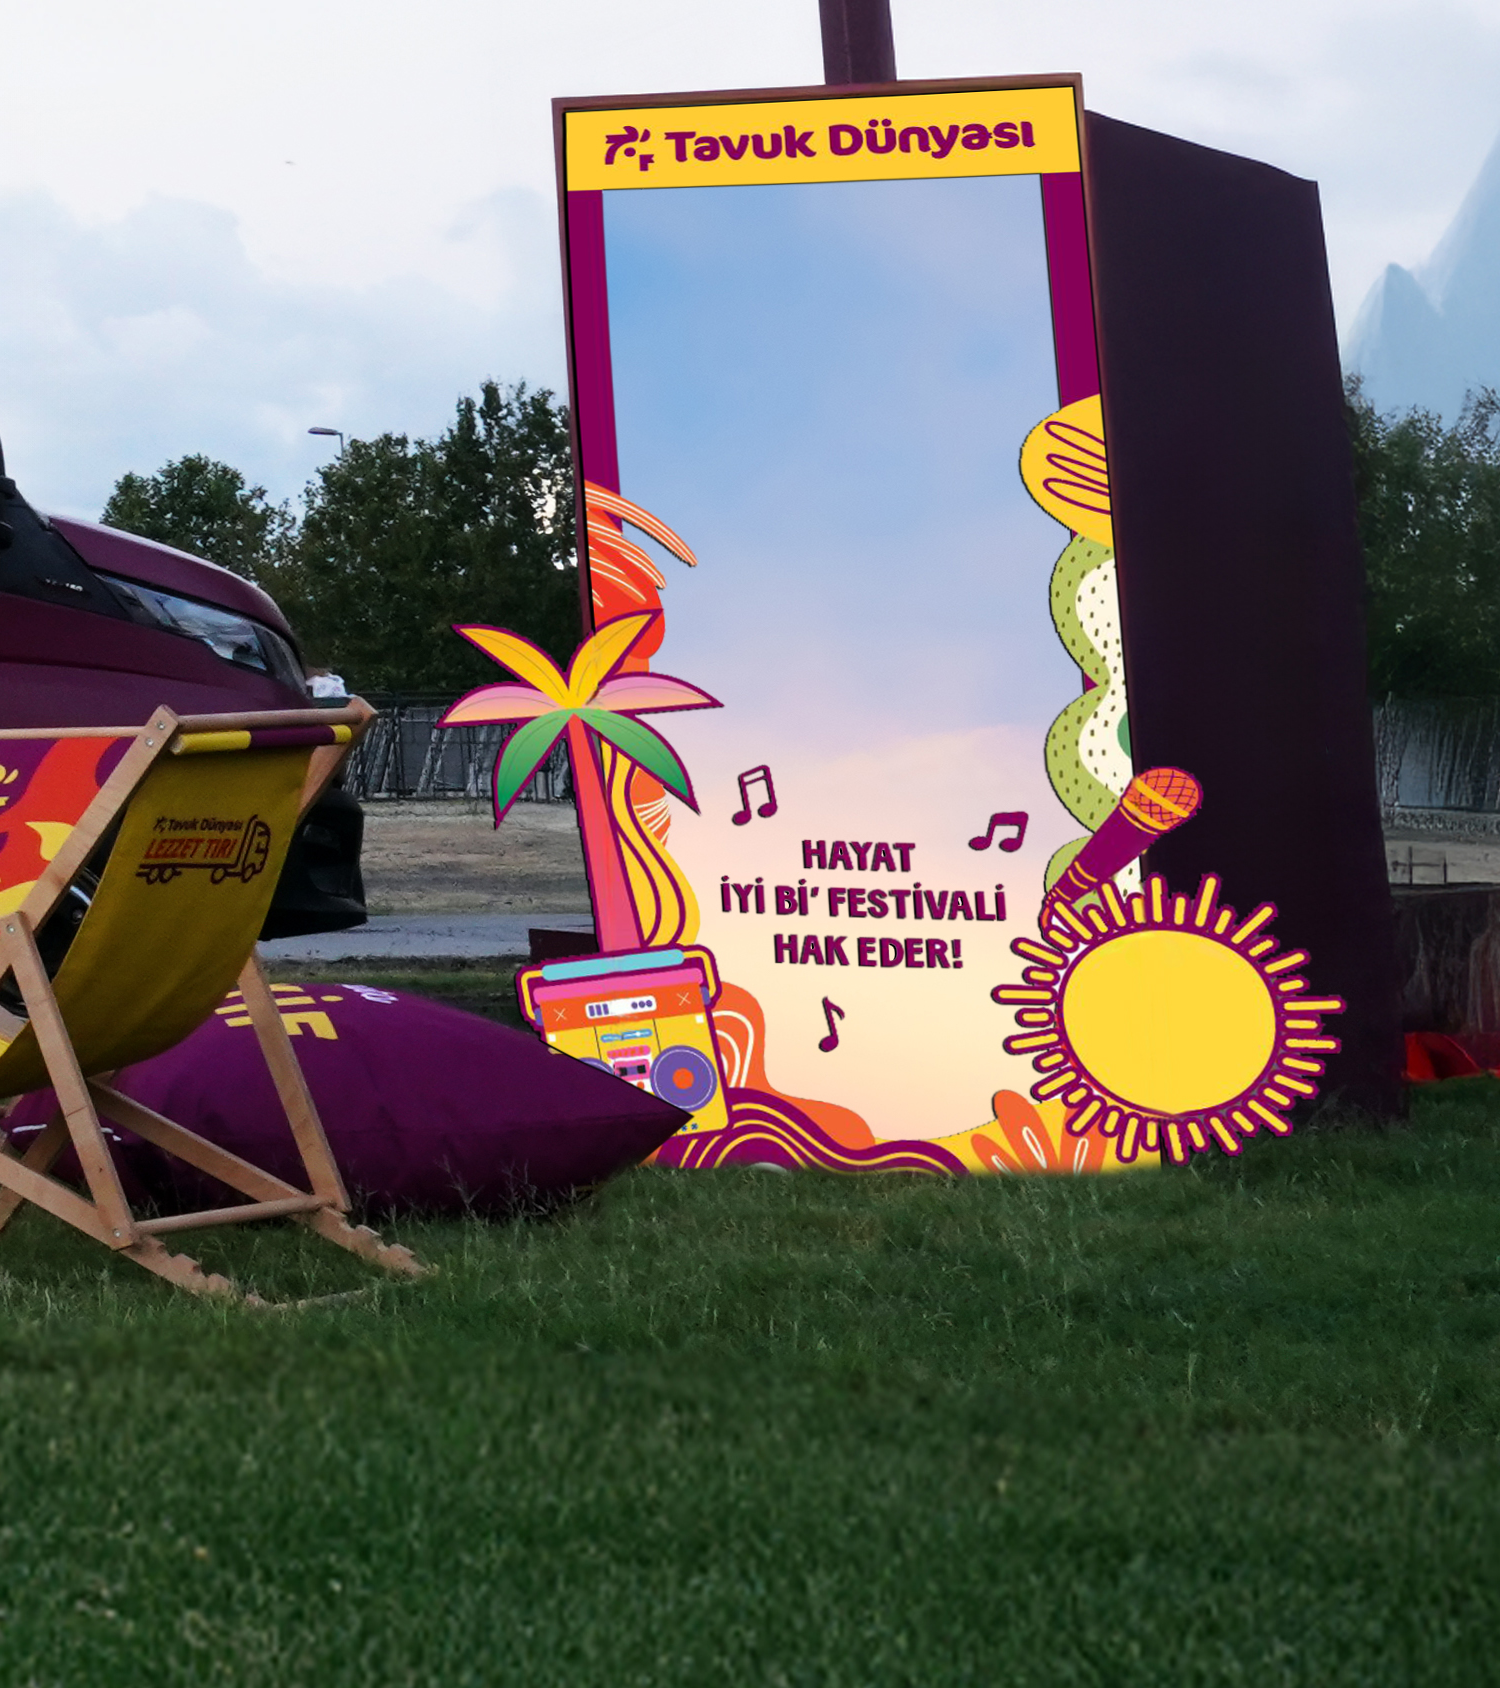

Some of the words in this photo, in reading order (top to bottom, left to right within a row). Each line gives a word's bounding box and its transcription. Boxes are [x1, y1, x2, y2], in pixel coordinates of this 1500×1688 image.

[664, 124, 813, 167] Tavuk
[828, 118, 1036, 161] Dünyası
[144, 838, 205, 859] LEZZET
[203, 838, 239, 859] TIRI
[801, 839, 916, 872] HAYAT
[720, 873, 766, 916] İYİ
[827, 880, 1007, 922] FESTİVALİ
[773, 932, 850, 969] HAK
[856, 934, 963, 970] EDER!
